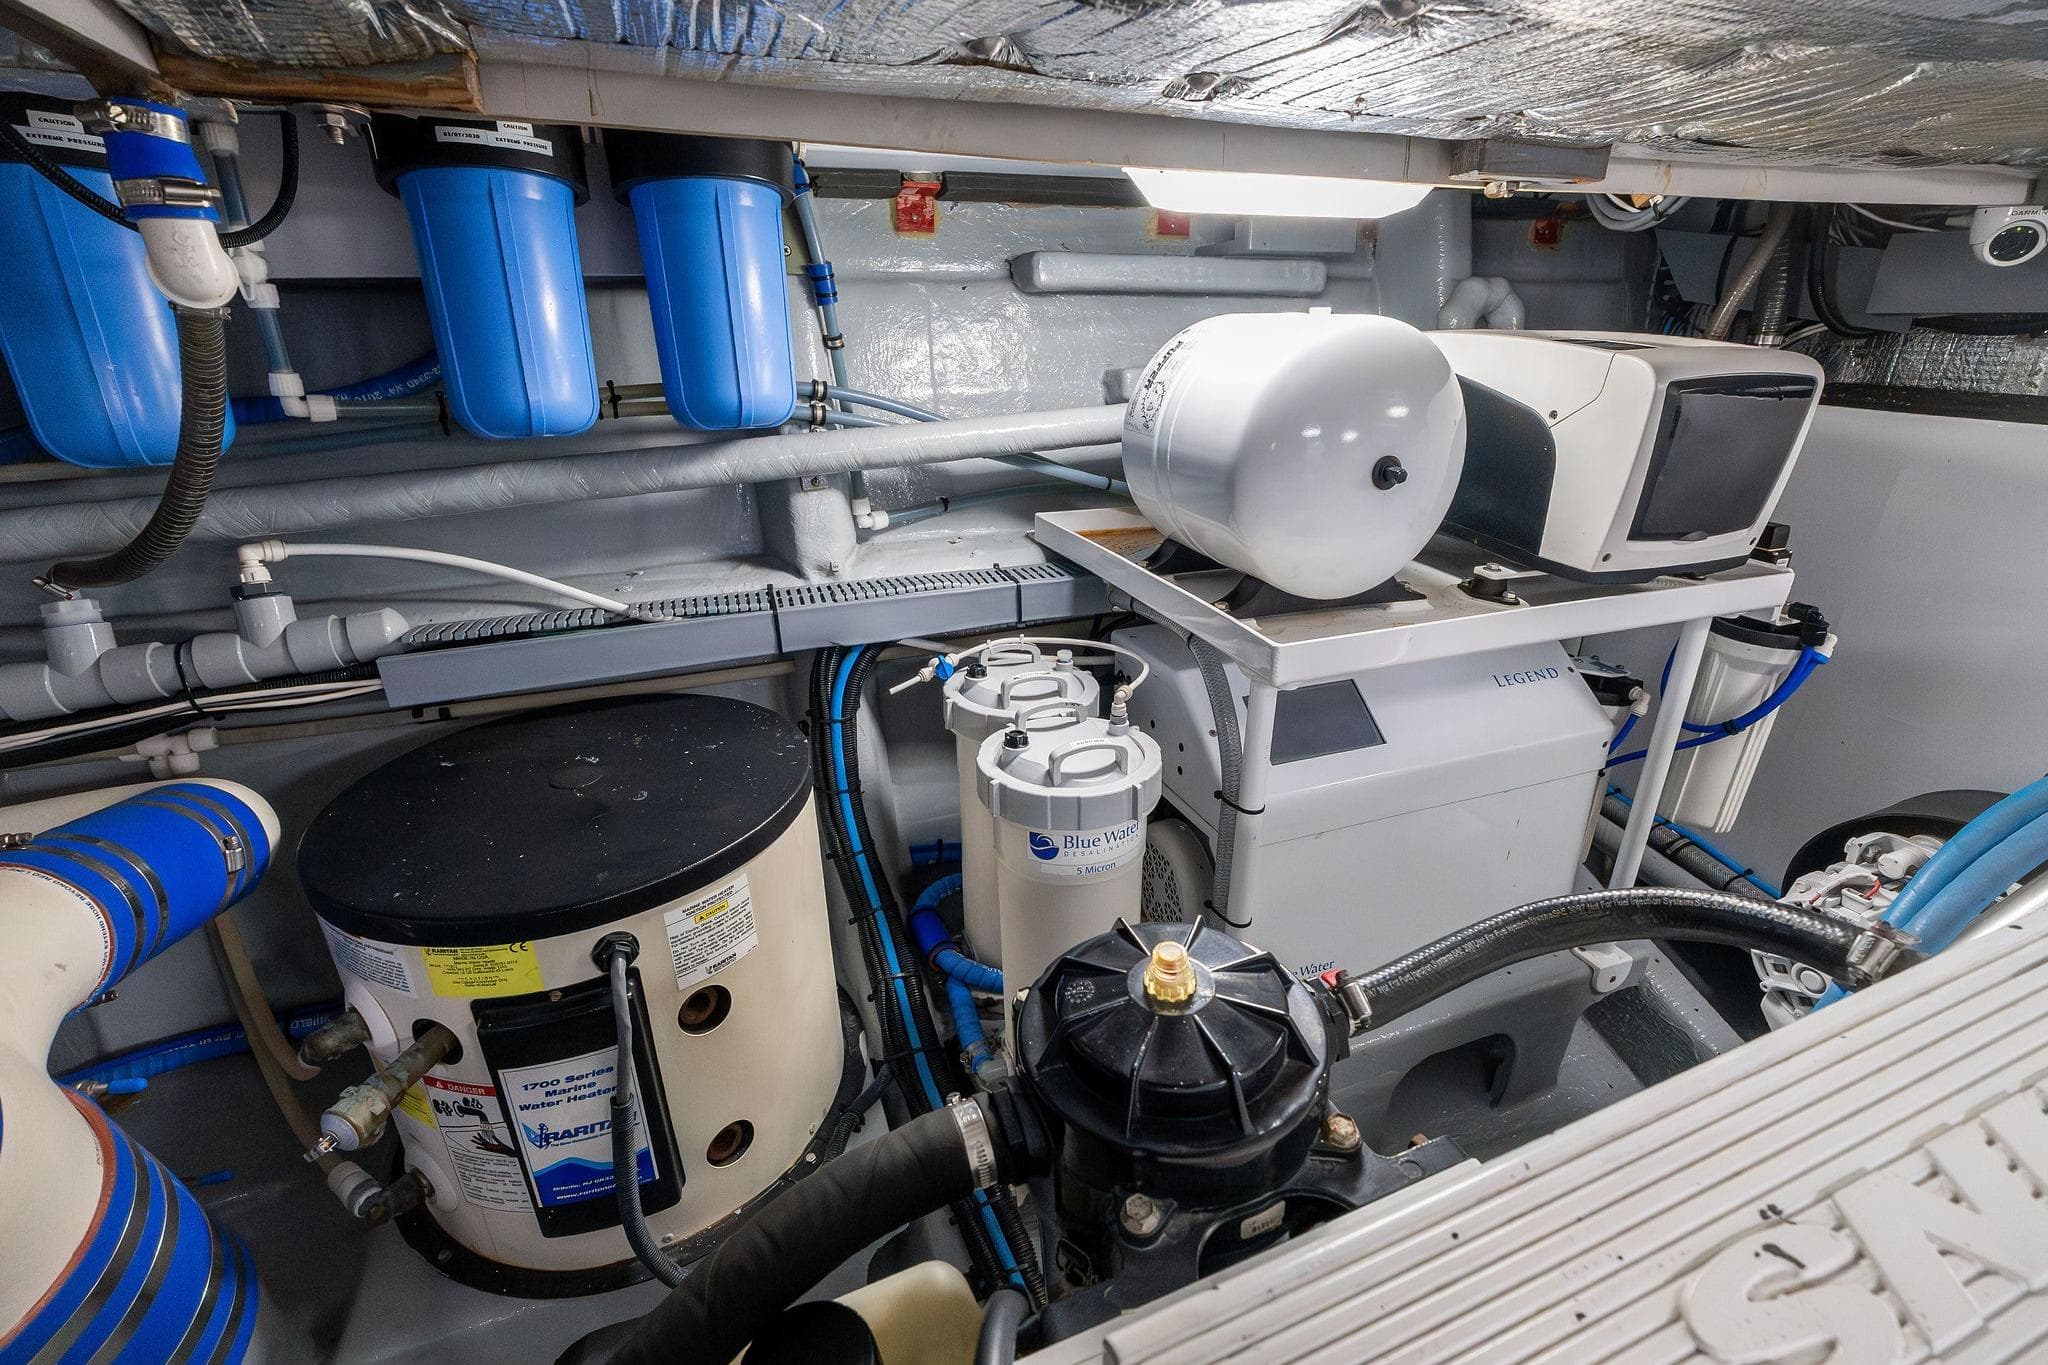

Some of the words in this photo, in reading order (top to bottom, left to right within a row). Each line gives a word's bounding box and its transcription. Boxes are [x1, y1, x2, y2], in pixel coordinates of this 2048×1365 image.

[38, 117, 76, 127] CAUTION
[25, 132, 64, 142] EXTREME
[495, 137, 520, 145] EXTREME
[523, 141, 548, 150] PRESSURE
[1492, 667, 1559, 687] LEGEND
[1063, 835, 1101, 850] Blue
[1077, 866, 1082, 875] 5
[1084, 861, 1116, 874] Micron
[705, 904, 726, 917] CAUTION
[712, 953, 737, 969] RARITAN
[1300, 960, 1335, 976] Water
[522, 1078, 561, 1091] 1700
[564, 1066, 614, 1083] Series
[447, 1083, 486, 1095] DANGER
[545, 1081, 597, 1098] Marine
[519, 1099, 563, 1112] Water
[567, 1085, 618, 1104] Heater
